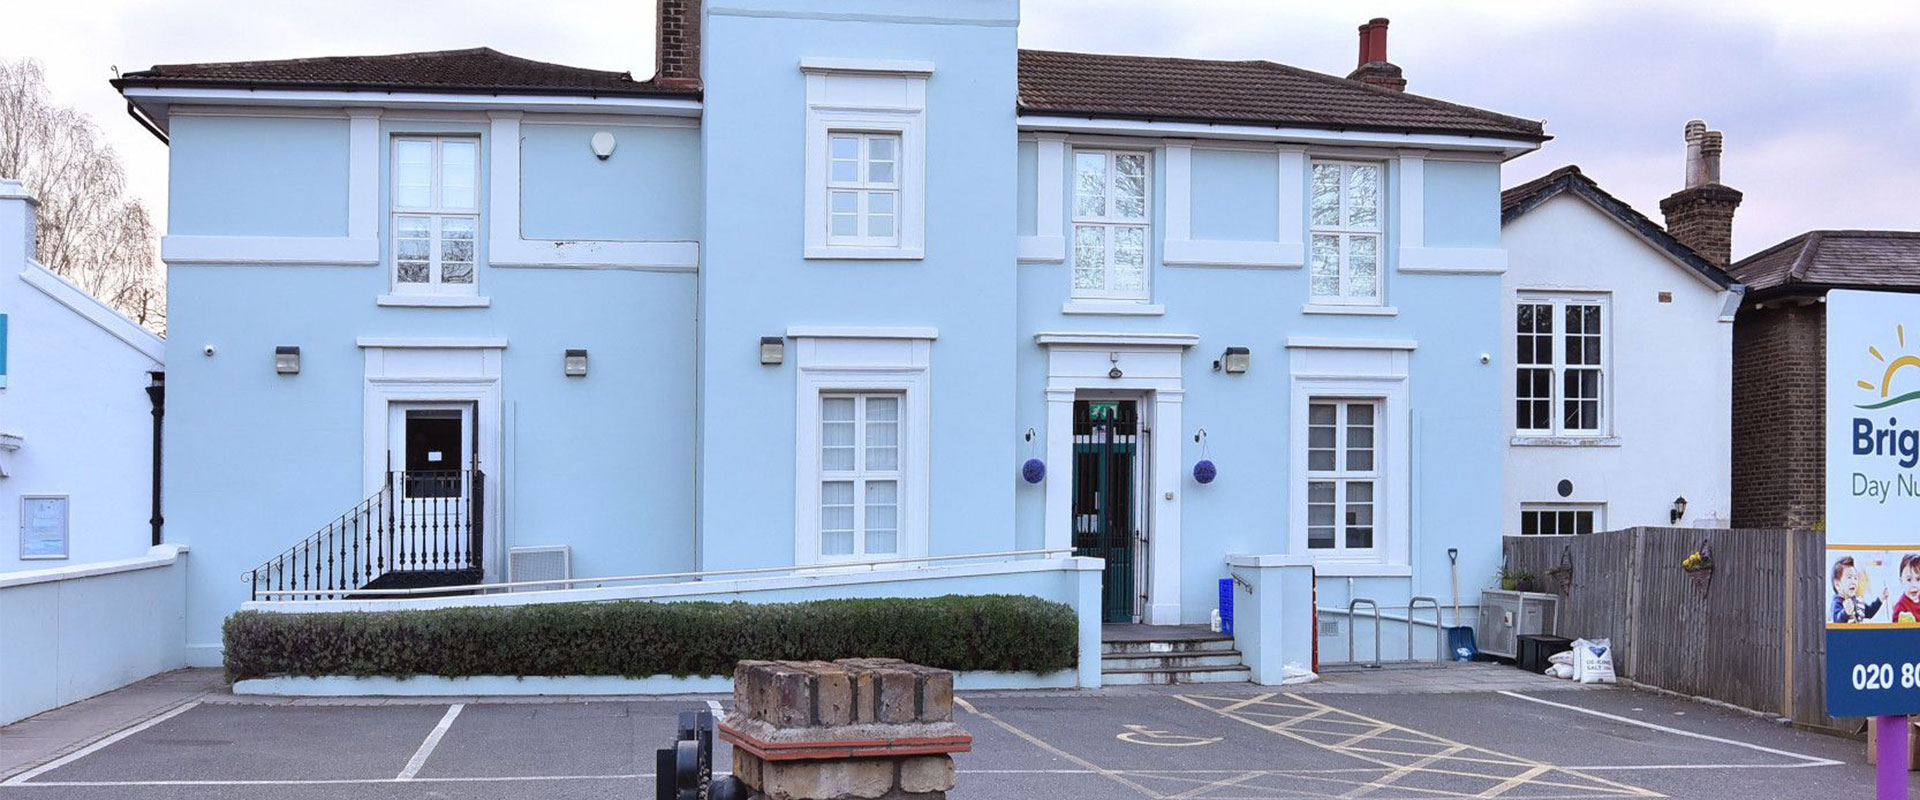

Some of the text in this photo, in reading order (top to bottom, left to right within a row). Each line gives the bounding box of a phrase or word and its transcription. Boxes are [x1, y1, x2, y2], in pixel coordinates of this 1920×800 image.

[1853, 417, 1919, 468] Brig
[1852, 472, 1890, 504] Day
[1852, 663, 1894, 690] 020
